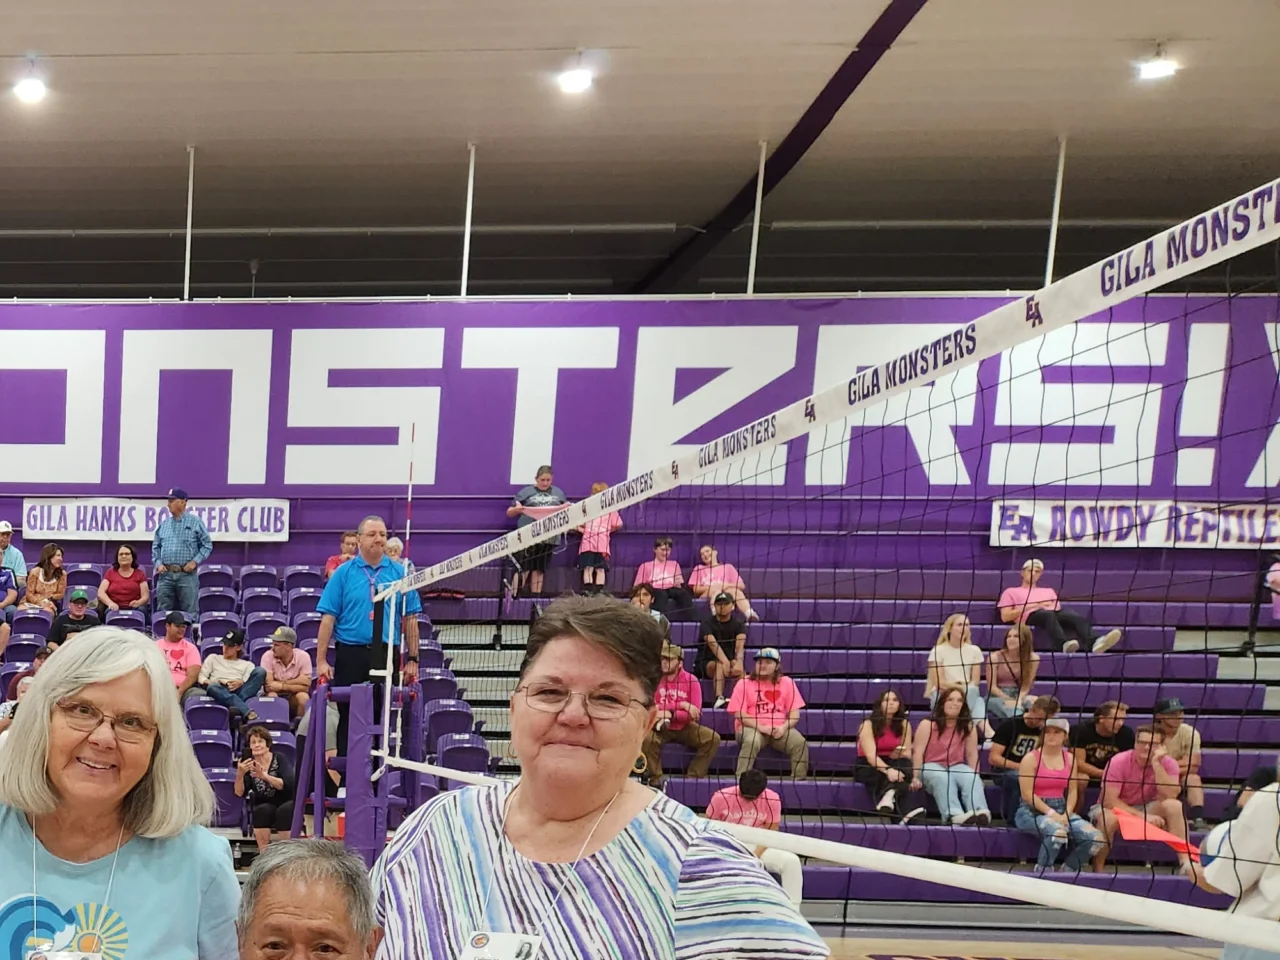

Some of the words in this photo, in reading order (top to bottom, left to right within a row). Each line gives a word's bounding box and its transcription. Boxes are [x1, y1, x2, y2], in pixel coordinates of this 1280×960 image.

[600, 489, 616, 510] GILA
[616, 470, 654, 505] MONSTERS
[698, 444, 719, 469] GILA
[722, 415, 777, 460] MONSTERS
[804, 399, 816, 423] EA
[847, 371, 881, 406] GILA
[885, 323, 977, 390] MONSTERS
[1025, 294, 1043, 328] EA
[1100, 239, 1156, 298] GILA
[26, 504, 68, 532] GILA
[75, 504, 137, 533] HANKS
[237, 506, 285, 534] CLUB
[999, 505, 1038, 541] EA
[1049, 505, 1157, 542] ROWDY
